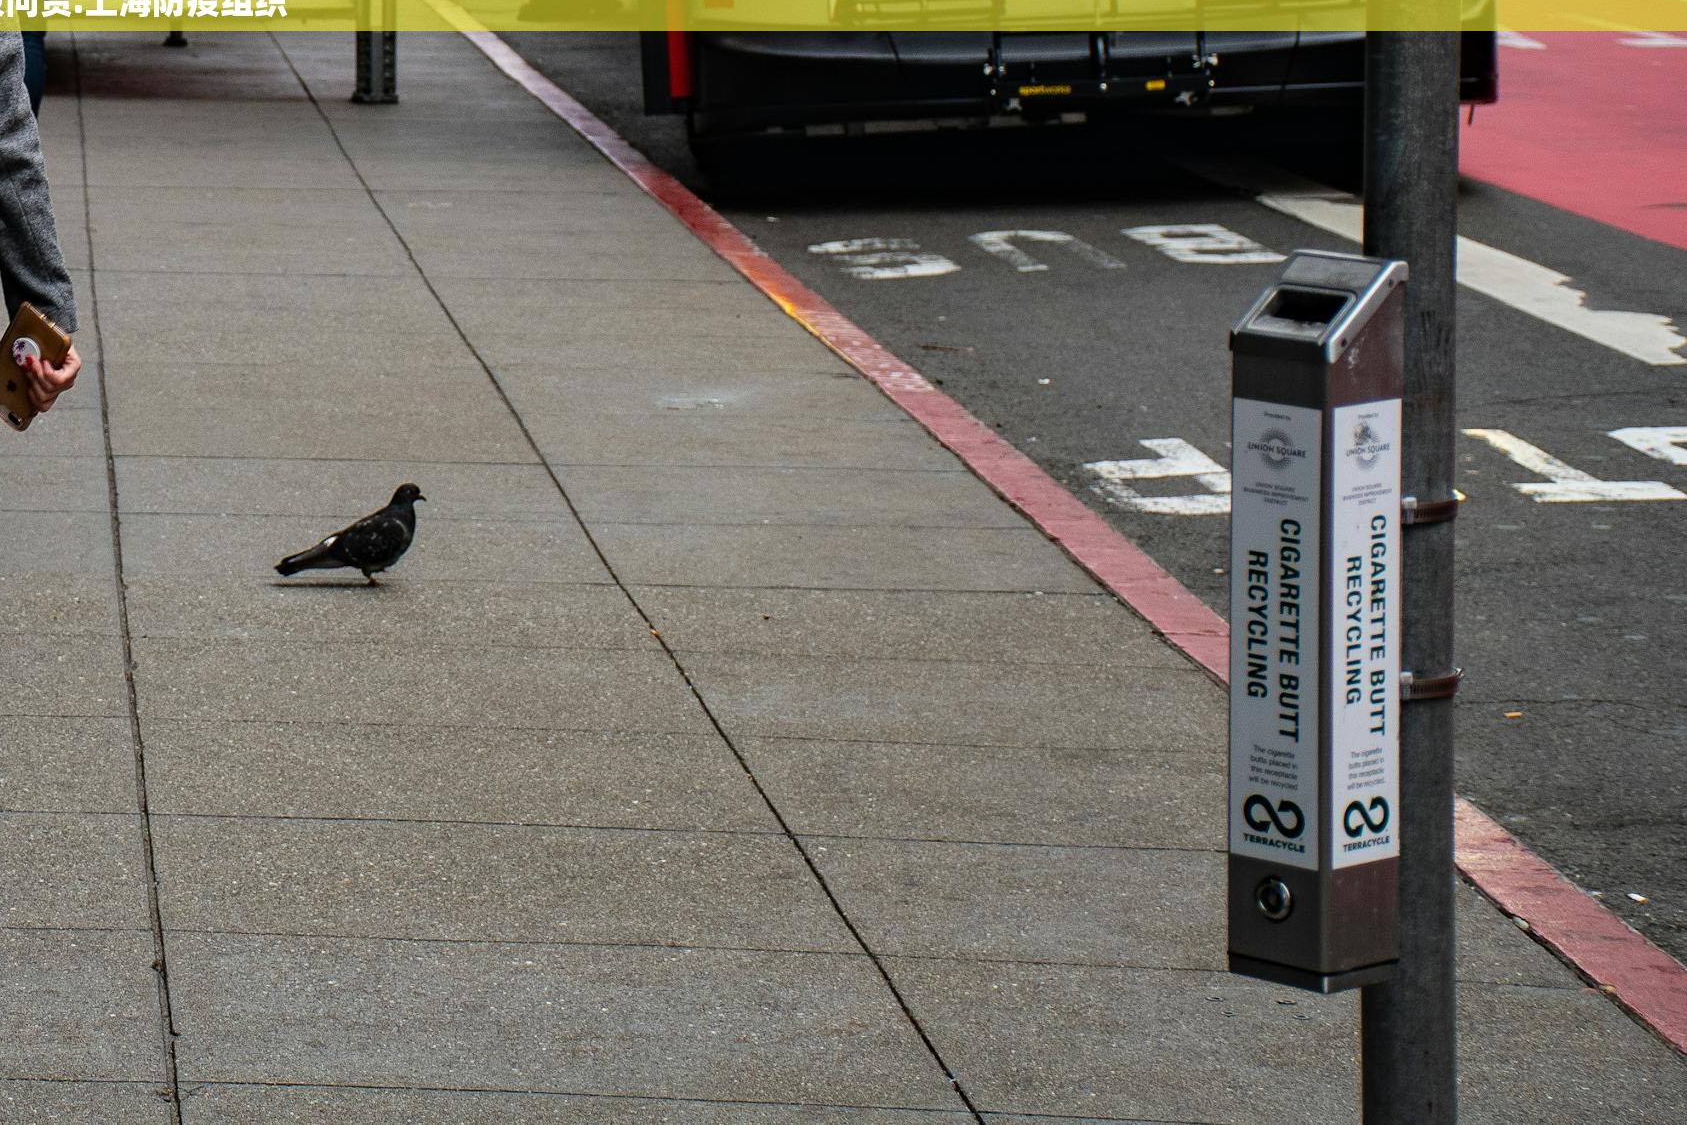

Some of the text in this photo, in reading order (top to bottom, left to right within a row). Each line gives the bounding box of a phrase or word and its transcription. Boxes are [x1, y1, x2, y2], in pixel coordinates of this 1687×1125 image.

[1248, 441, 1307, 458] UNION SQUARE
[1346, 443, 1391, 457] UNION SQUARE
[1247, 549, 1269, 699] RECYCLING
[1278, 518, 1301, 743] CIGARETTE BUTT
[1346, 555, 1363, 705] RECYCLING
[1369, 514, 1387, 736] CIGARETTE BUTT
[1243, 833, 1306, 853] TERRACYCLE
[1343, 835, 1391, 853] TERRACYCLE
